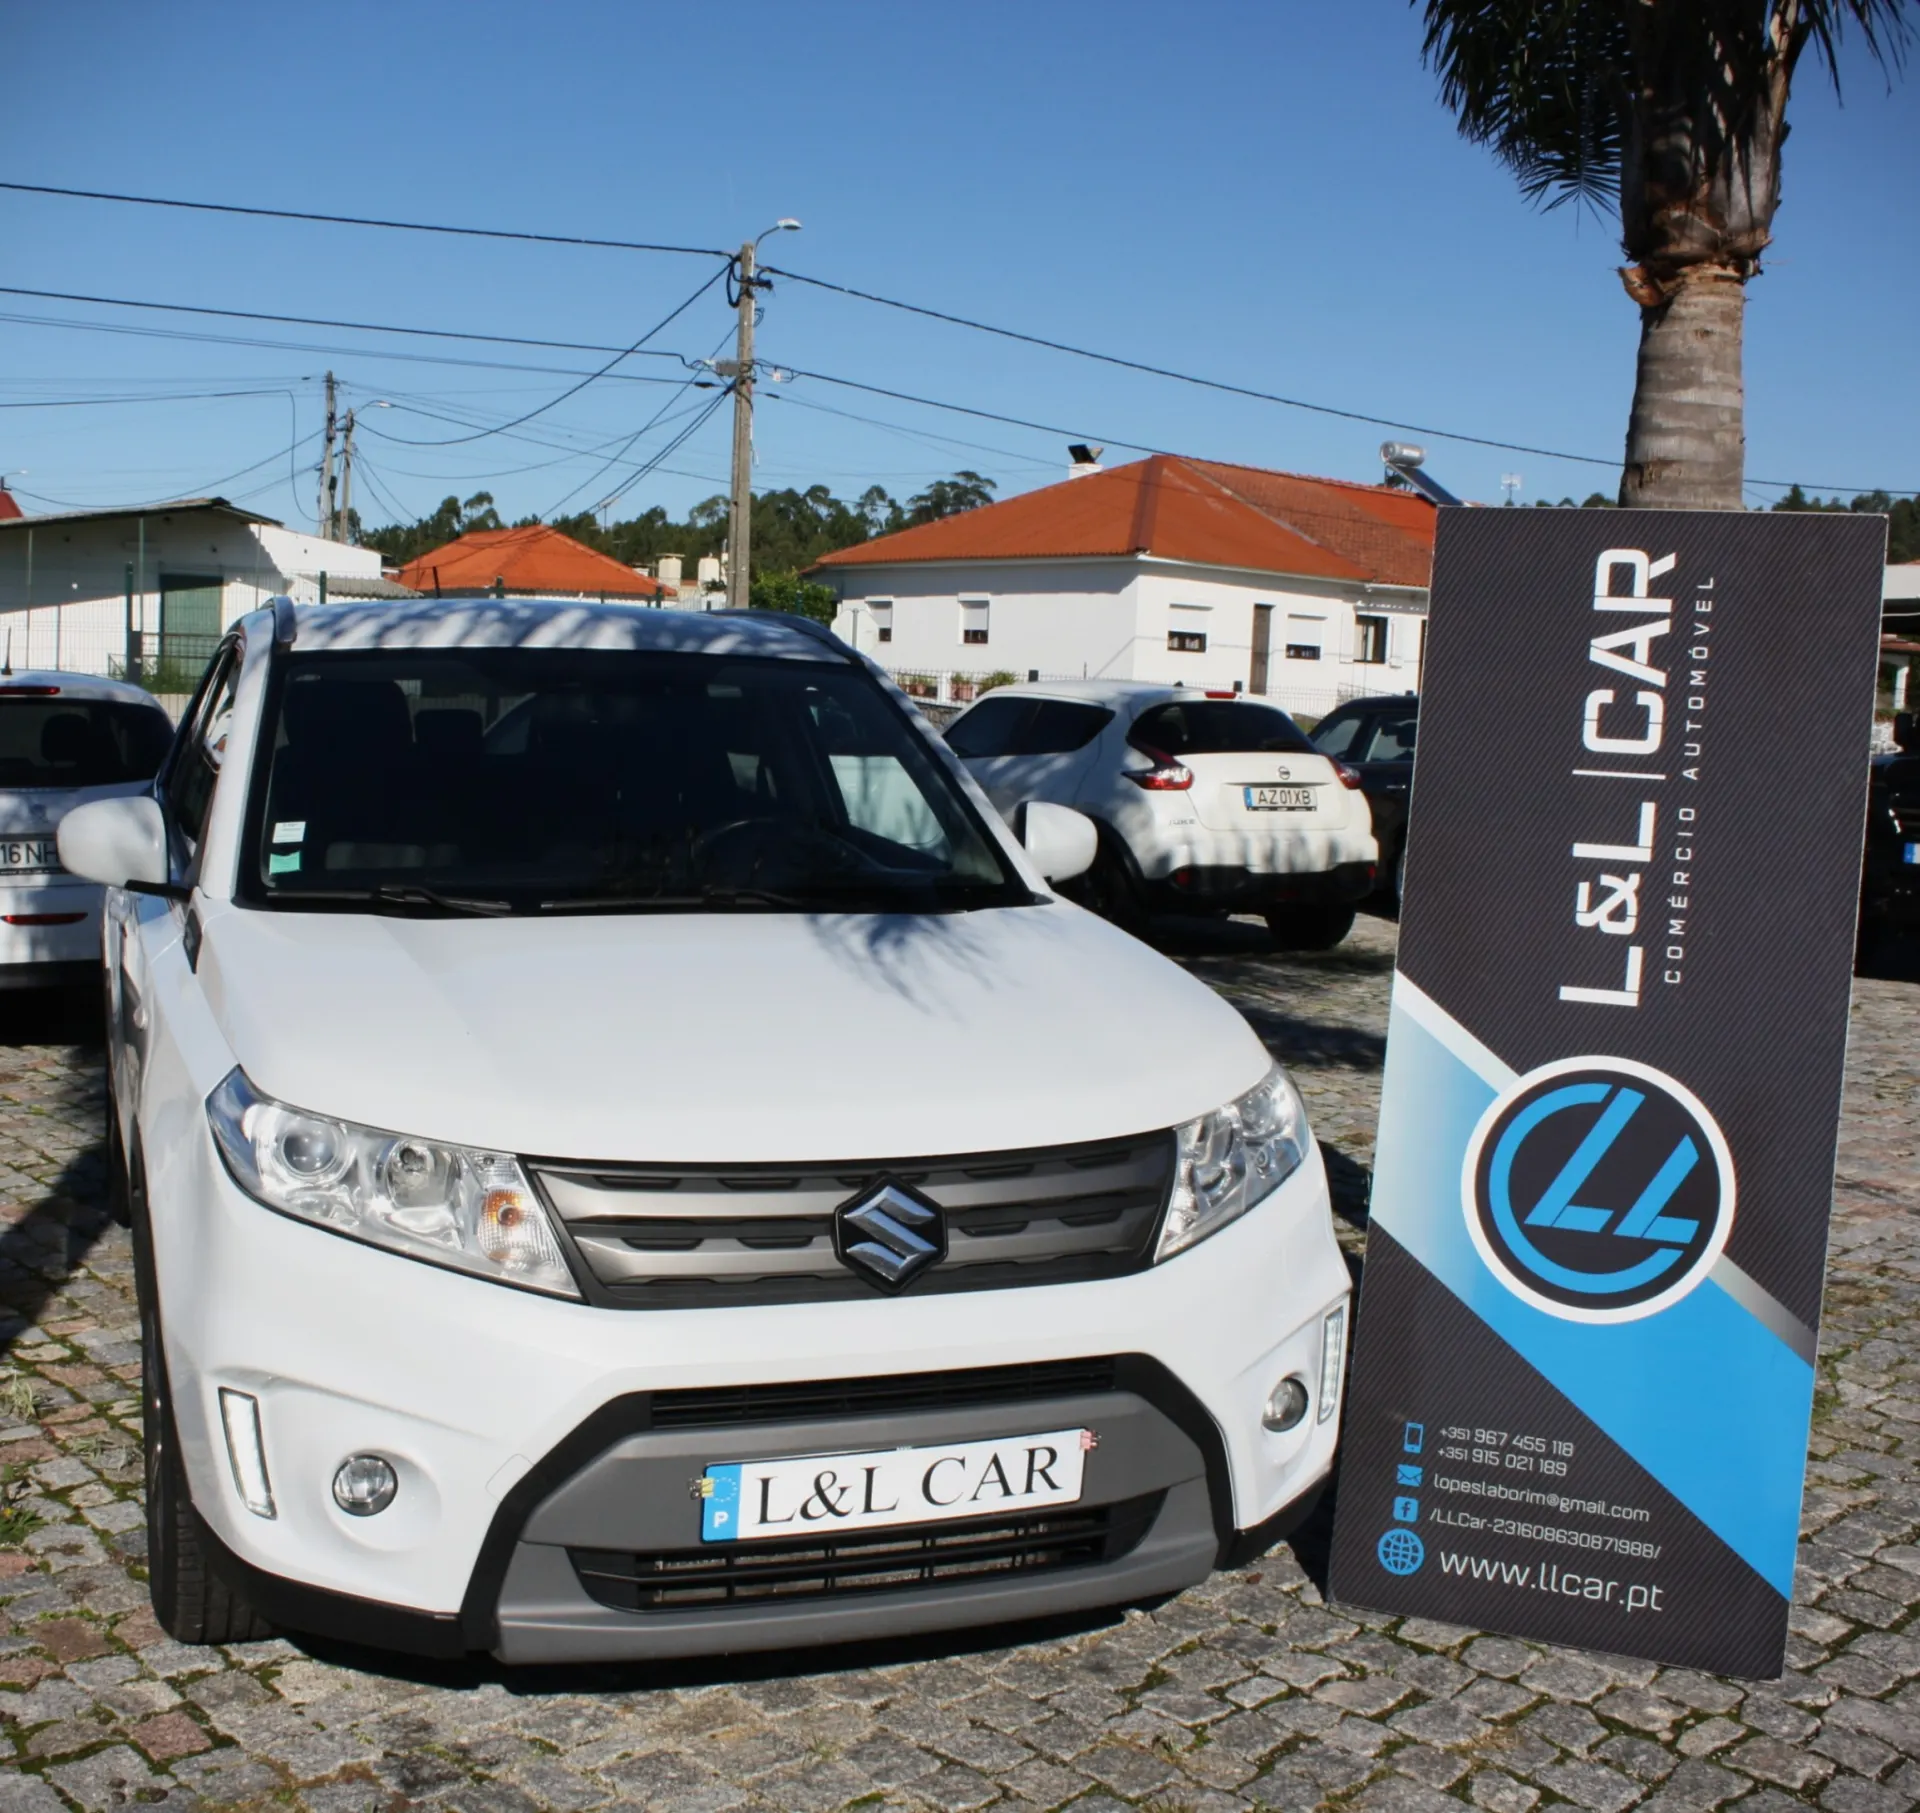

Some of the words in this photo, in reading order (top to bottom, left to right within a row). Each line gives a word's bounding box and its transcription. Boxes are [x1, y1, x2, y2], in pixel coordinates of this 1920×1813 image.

[1582, 548, 1676, 755] CAR
[1664, 807, 1696, 984] COMÉRCIO
[1683, 577, 1714, 780] AUTOMÓVEL
[1559, 801, 1656, 1007] L&L
[1437, 1446, 1468, 1461] +351
[1471, 1448, 1500, 1466] 915
[1505, 1454, 1533, 1471] 021
[1539, 1458, 1568, 1476] 189
[1439, 1426, 1470, 1441] +351
[1474, 1428, 1508, 1446] 967
[1512, 1435, 1547, 1453] 455
[1552, 1440, 1574, 1457] 118
[755, 1465, 899, 1526] L&L
[921, 1446, 1063, 1506] CAR
[1433, 1472, 1650, 1522] lopeslaborim@gmail.com
[713, 1511, 729, 1528] P
[1440, 1551, 1664, 1612] www.llcar.pt
